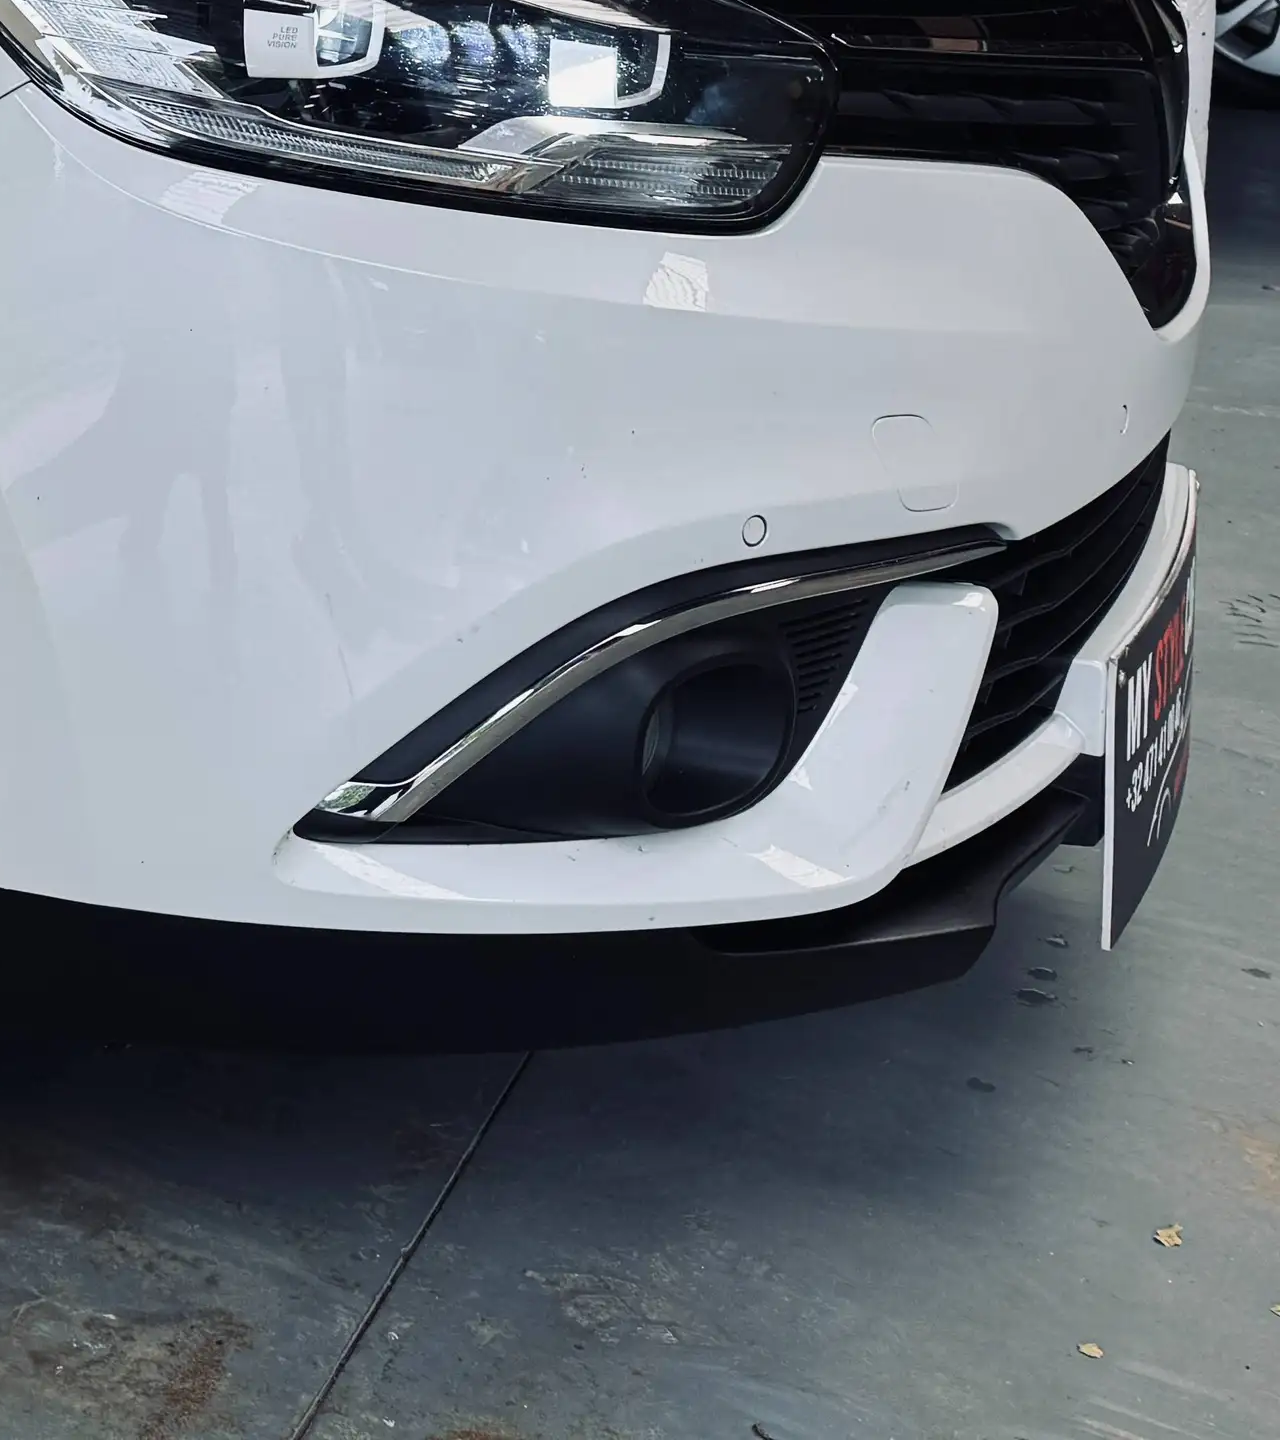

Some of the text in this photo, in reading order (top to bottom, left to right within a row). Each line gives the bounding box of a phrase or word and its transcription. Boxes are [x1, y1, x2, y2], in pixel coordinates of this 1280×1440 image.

[280, 26, 299, 34] LED
[272, 32, 298, 42] PURE
[267, 40, 298, 49] VISION
[1126, 651, 1154, 762] MY
